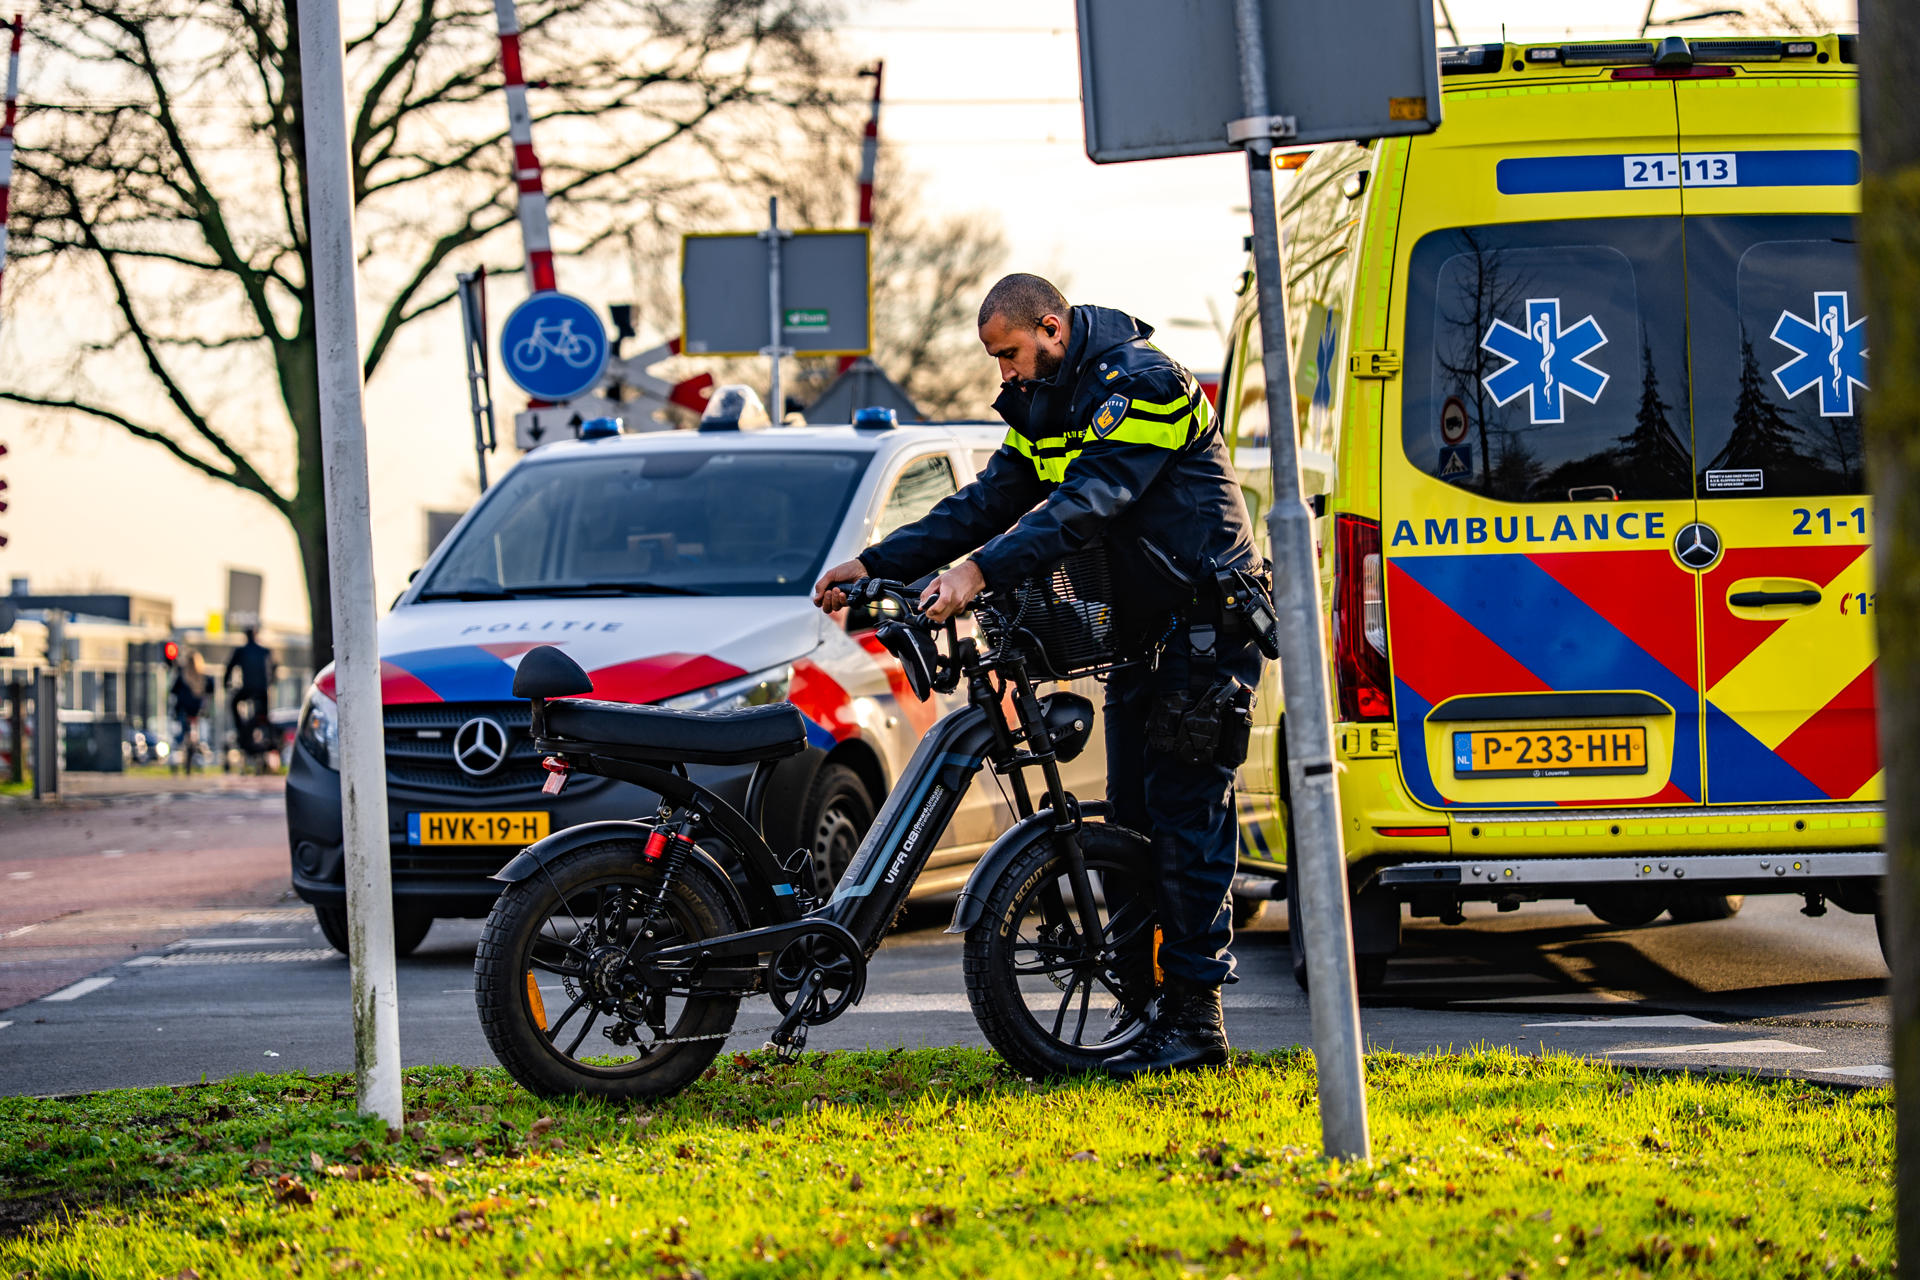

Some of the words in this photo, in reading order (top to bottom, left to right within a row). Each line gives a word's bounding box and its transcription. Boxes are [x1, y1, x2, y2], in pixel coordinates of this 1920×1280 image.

[1632, 159, 1729, 182] 21-113
[1391, 512, 1665, 546] AMBULANCE
[1793, 507, 1867, 535] 21-1
[460, 620, 624, 635] POLITIE
[1457, 756, 1470, 765] NL
[1484, 734, 1631, 765] P-233-HH
[429, 817, 538, 840] HVK-19-H
[884, 851, 908, 884] VIFA
[999, 900, 1017, 937] CST
[1015, 866, 1044, 903] SCOUT
